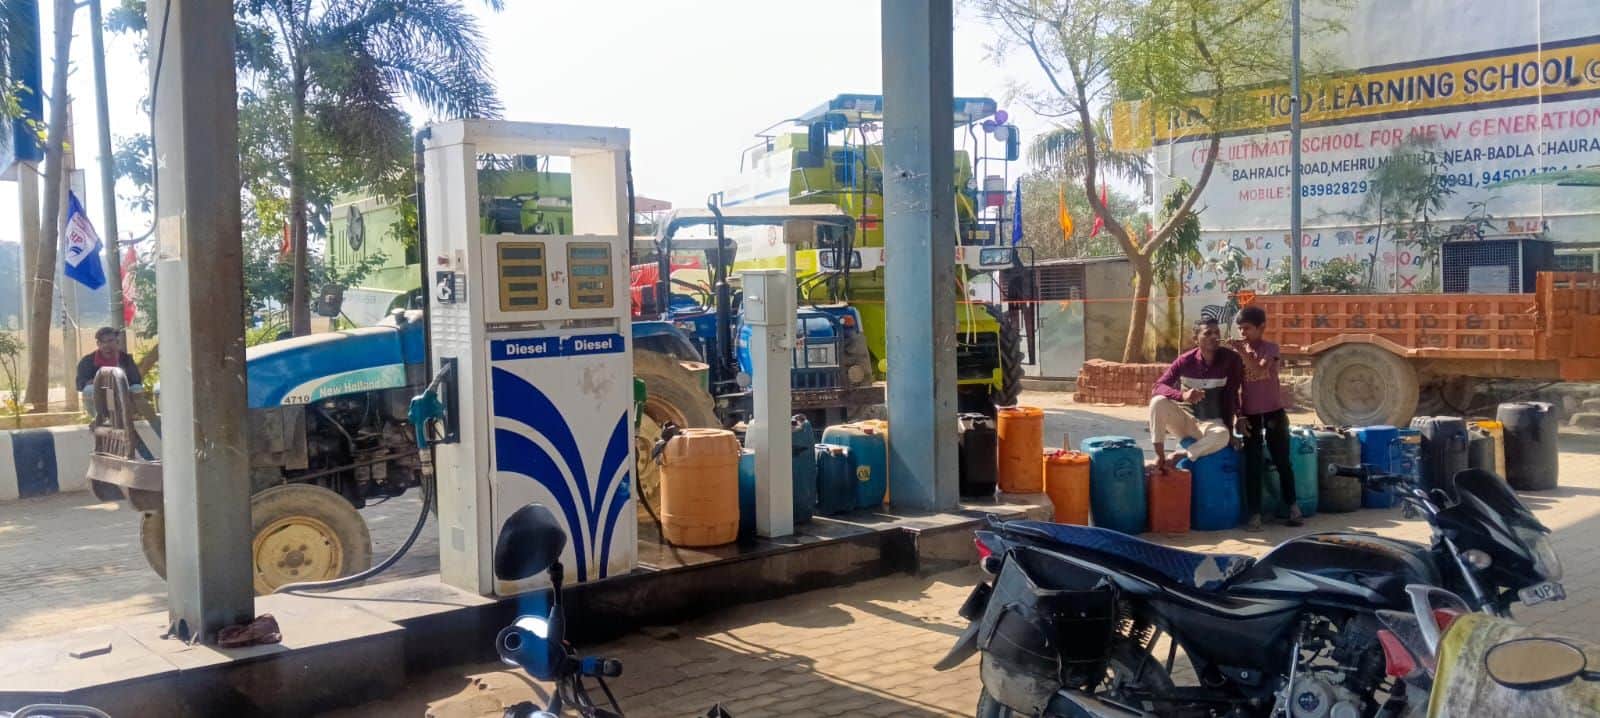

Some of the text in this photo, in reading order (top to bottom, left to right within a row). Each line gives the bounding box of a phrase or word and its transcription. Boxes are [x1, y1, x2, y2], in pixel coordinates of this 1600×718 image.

[1318, 71, 1454, 113] LEARNING
[1463, 55, 1580, 94] SCHOOL
[1228, 138, 1292, 161] ULTIMAT
[1302, 132, 1363, 153] SCHOOL
[1370, 128, 1403, 146] FOR
[505, 338, 612, 356] Diesel Diesel
[319, 386, 341, 397] New
[344, 380, 379, 392] Holland
